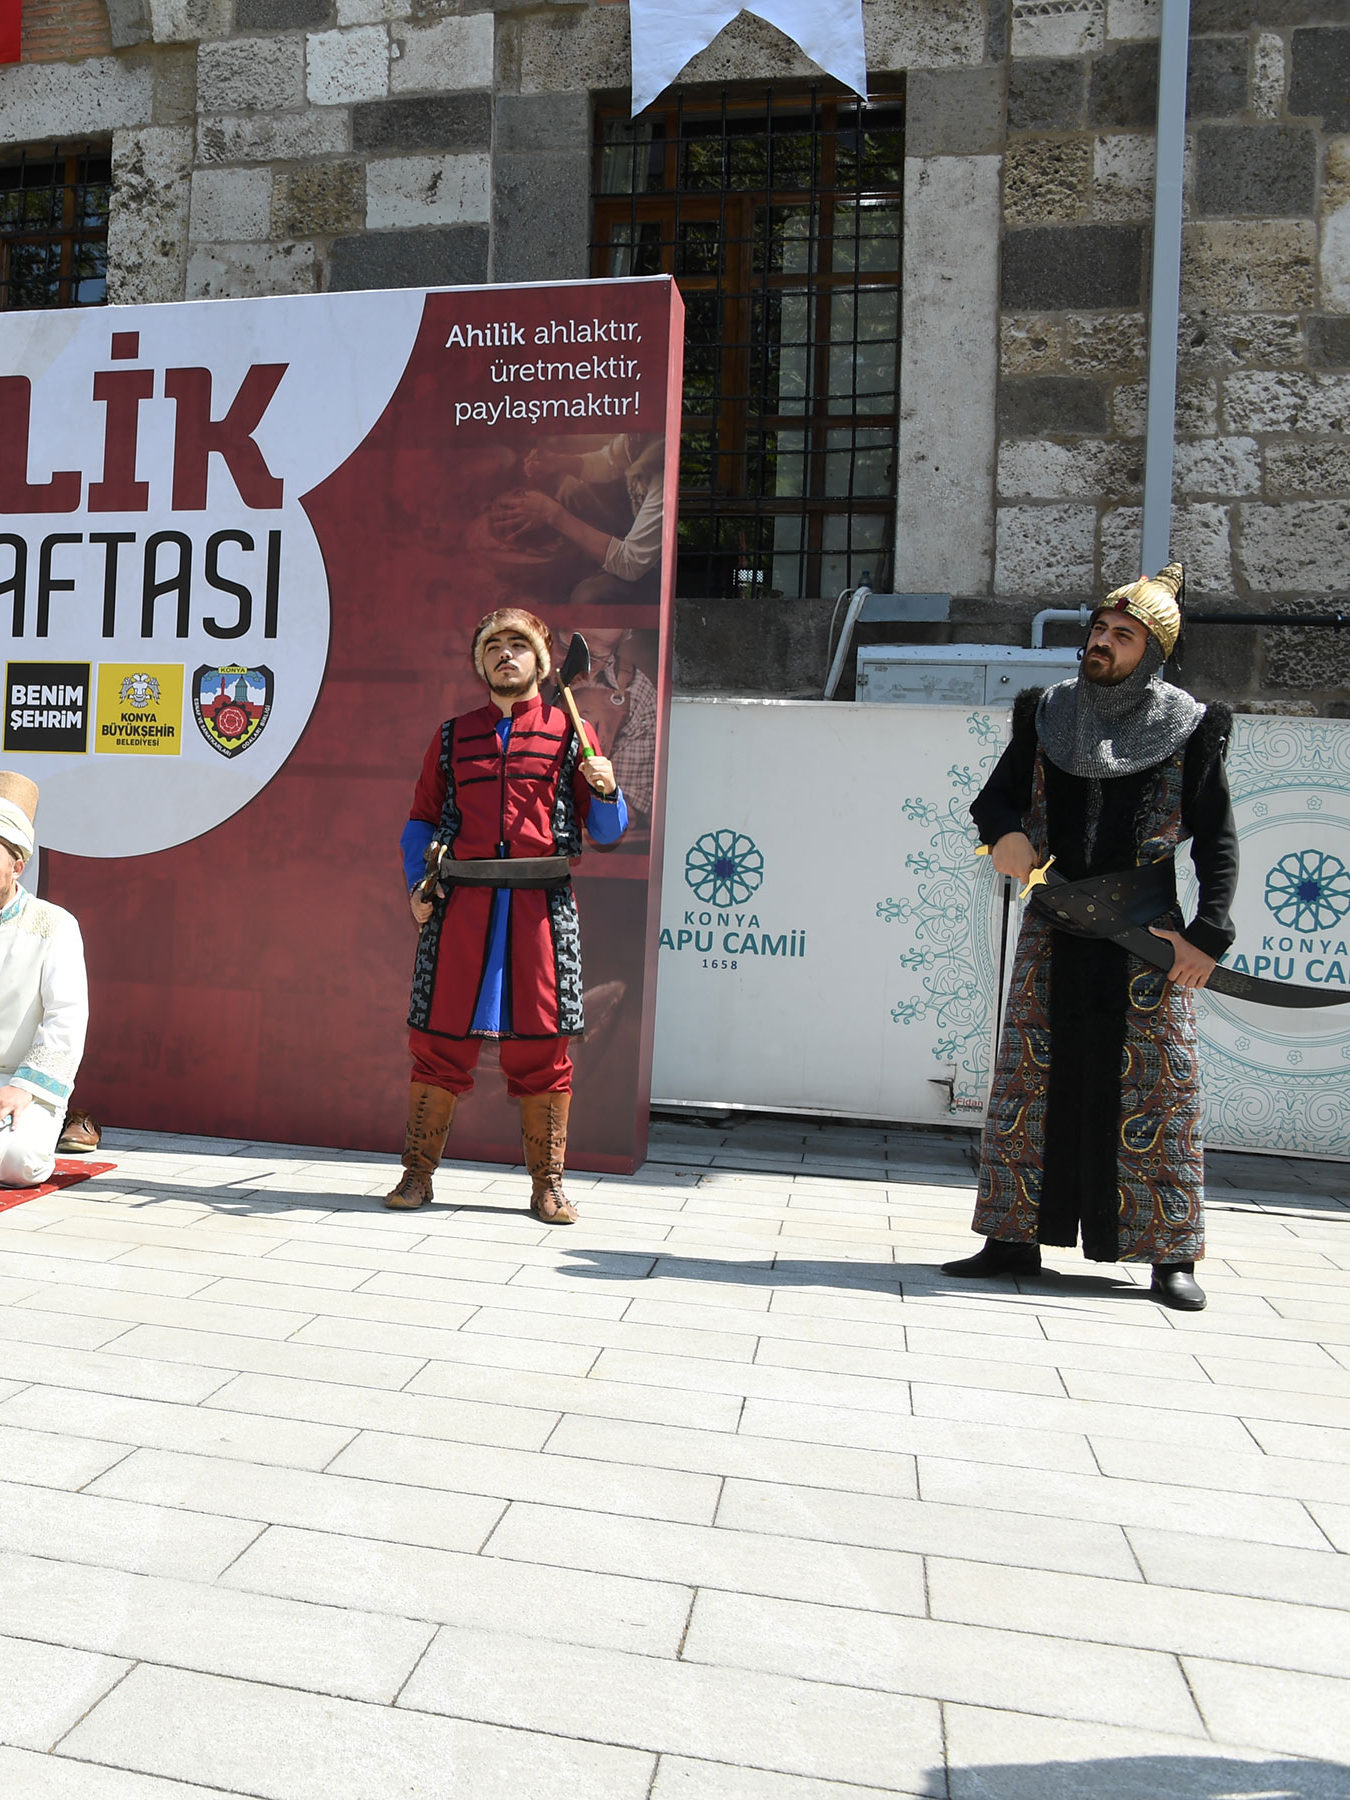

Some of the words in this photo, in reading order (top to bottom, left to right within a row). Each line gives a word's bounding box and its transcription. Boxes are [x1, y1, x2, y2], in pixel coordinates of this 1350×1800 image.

[445, 321, 526, 348] Ahilik
[533, 319, 642, 344] ahlaktır,
[490, 355, 641, 383] üretmektir,
[455, 392, 640, 426] paylaşmaktır!
[121, 713, 157, 722] KONYA
[102, 722, 175, 738] BÜYÜKŞEHİR
[116, 738, 159, 746] BELEDİYESİ
[684, 911, 760, 928] KONYA
[659, 928, 713, 952] APU
[1262, 936, 1348, 956] KONYA
[702, 959, 738, 970] 1658
